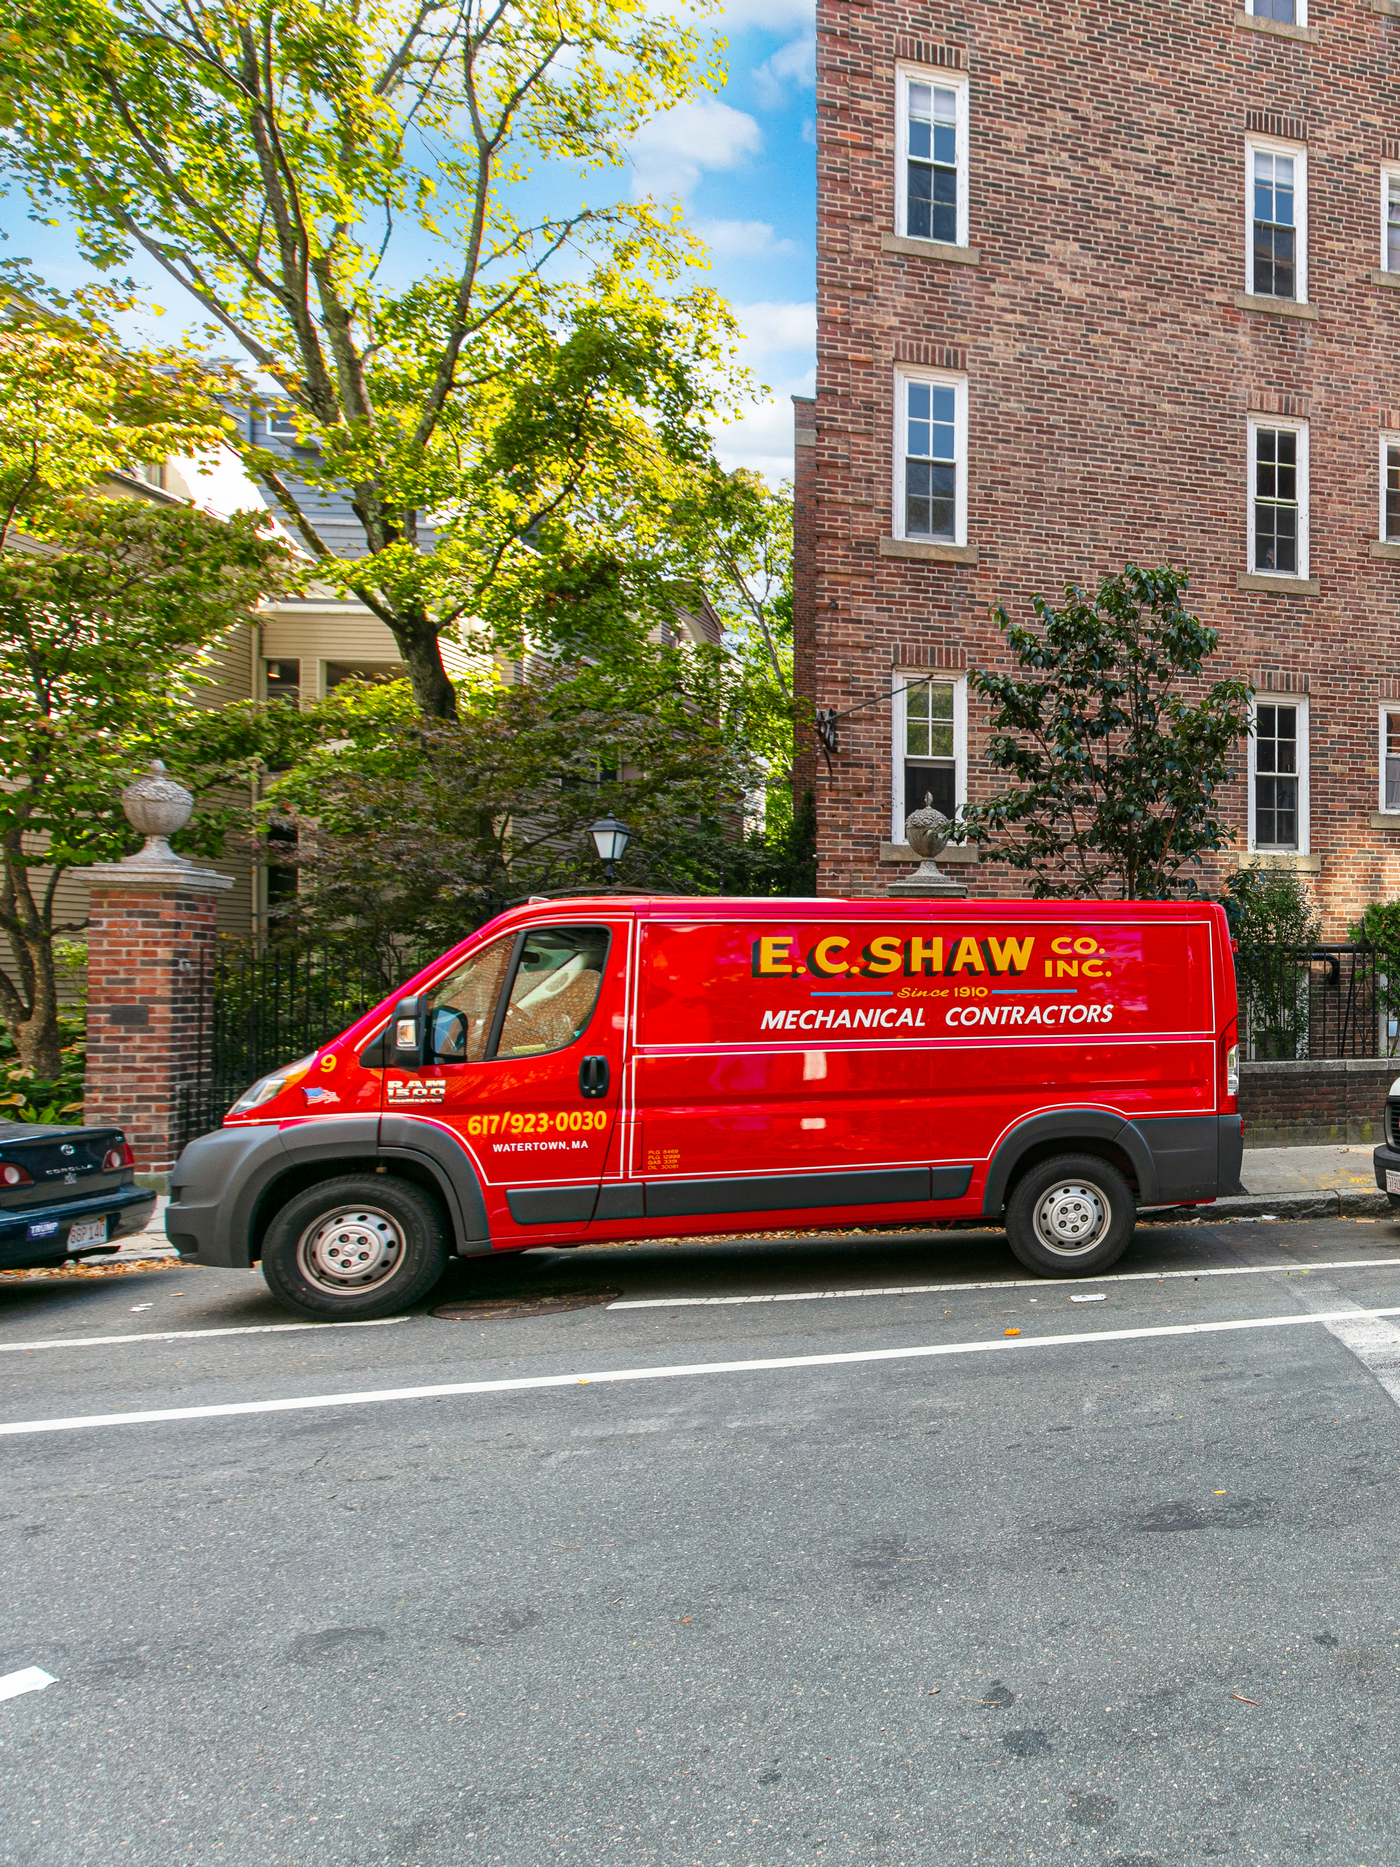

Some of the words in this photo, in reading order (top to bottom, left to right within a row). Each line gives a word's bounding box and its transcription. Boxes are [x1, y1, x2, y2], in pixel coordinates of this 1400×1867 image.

[1051, 937, 1106, 955] CO.
[1044, 959, 1112, 978] INC.
[897, 986, 949, 999] Since
[954, 986, 988, 998] 1910
[760, 1007, 926, 1030] MECHANICAL
[945, 1004, 1114, 1026] CONTRACTORS
[320, 1053, 337, 1073] 9
[387, 1080, 446, 1089] RAM
[387, 1088, 446, 1098] 1500
[571, 1140, 589, 1149] MA
[45, 1164, 94, 1175] COROLLA
[30, 1222, 59, 1234] TRUMP
